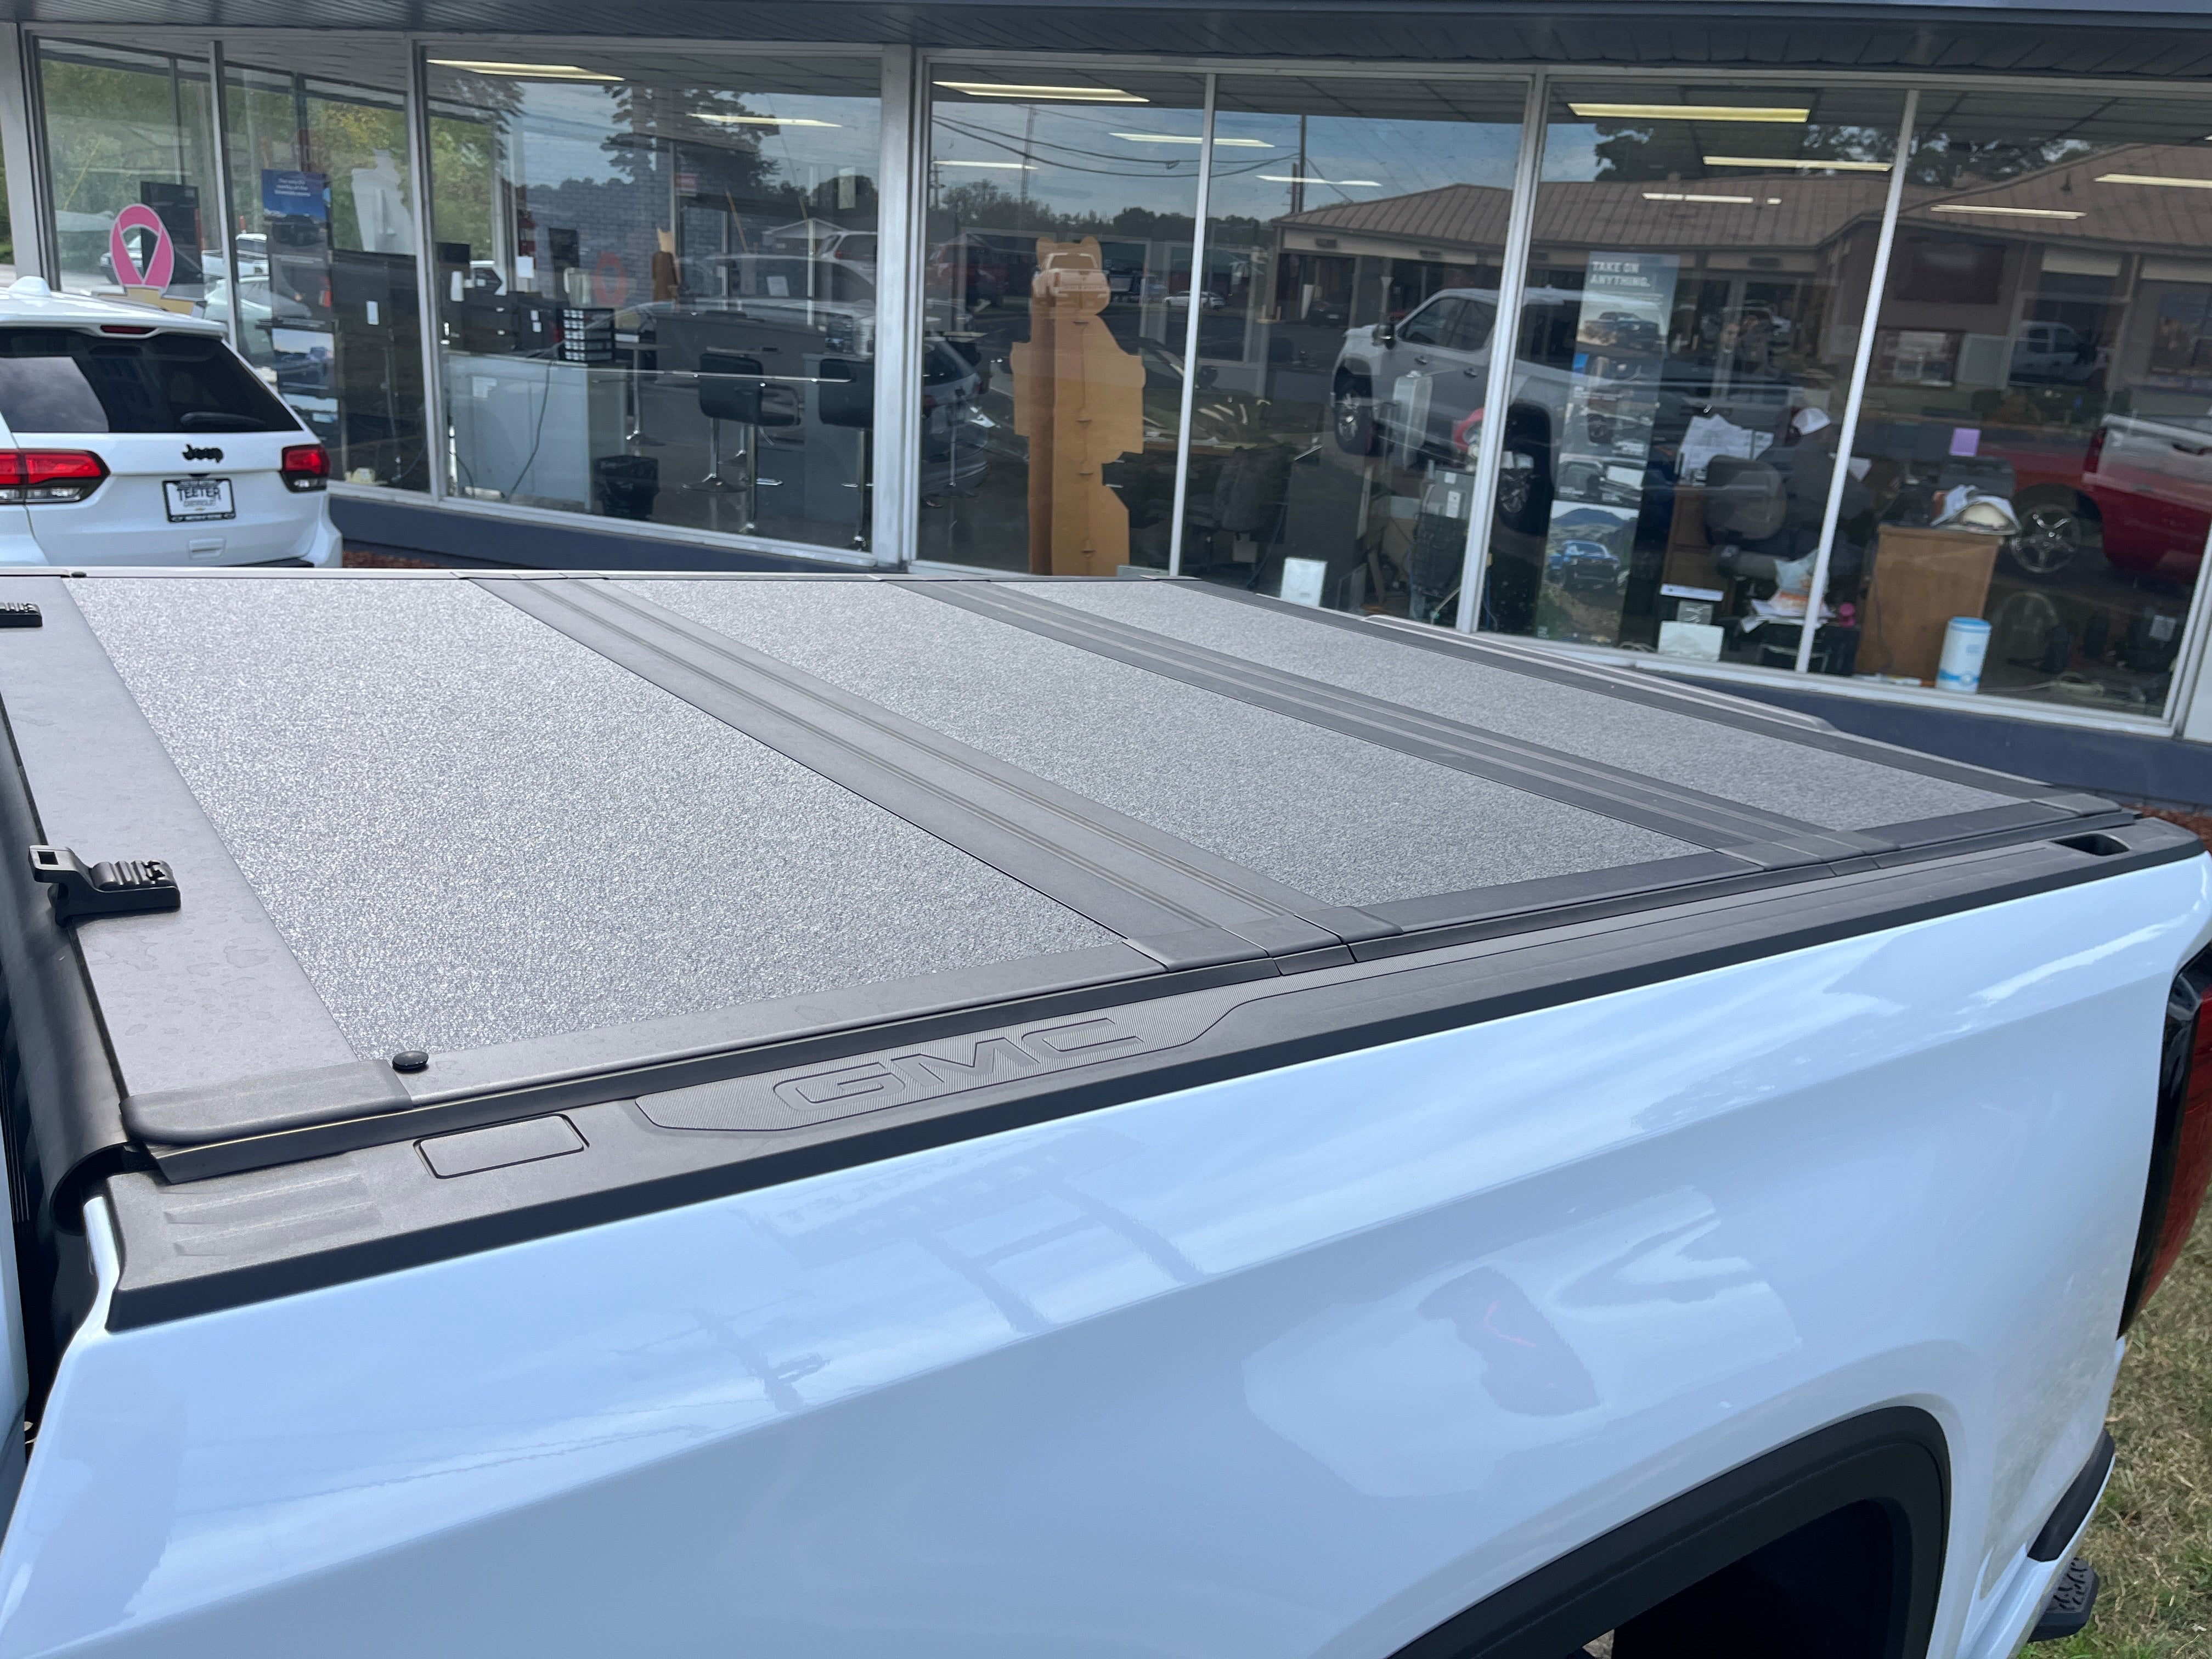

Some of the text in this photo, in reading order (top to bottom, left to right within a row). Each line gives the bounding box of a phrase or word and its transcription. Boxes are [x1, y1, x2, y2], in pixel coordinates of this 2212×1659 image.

[1592, 261, 1622, 273] TAKE
[182, 443, 223, 463] Jeep
[177, 485, 222, 501] TEETER
[773, 1017, 1145, 1111] GMC
